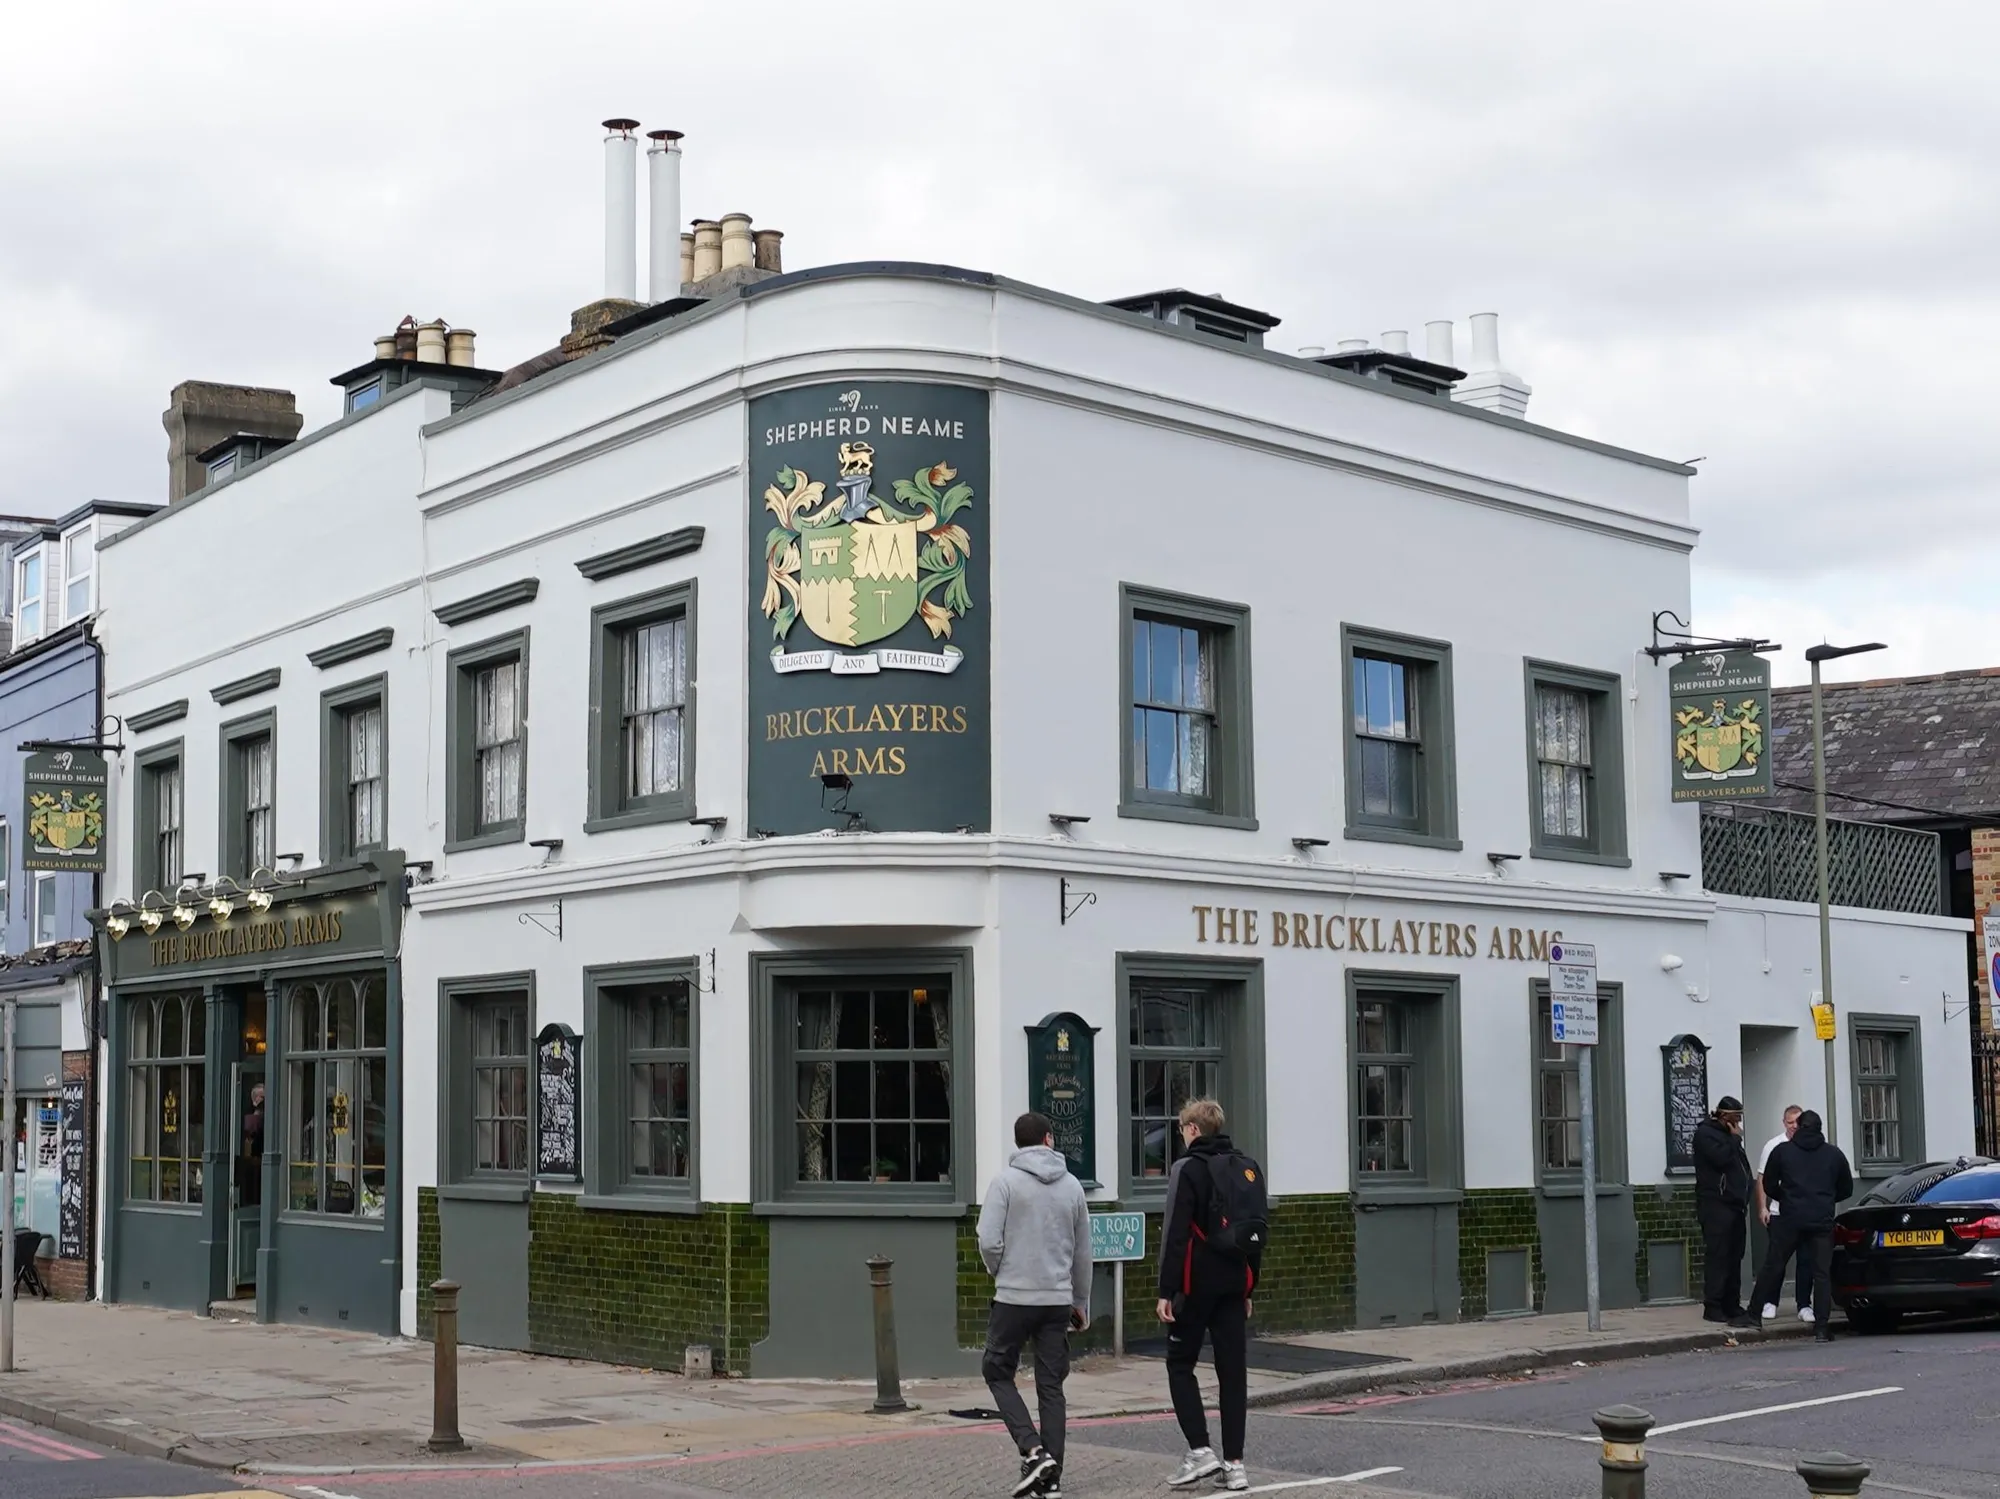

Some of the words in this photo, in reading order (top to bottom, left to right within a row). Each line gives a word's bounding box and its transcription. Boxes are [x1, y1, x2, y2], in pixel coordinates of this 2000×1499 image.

[766, 416, 871, 446] SHEPHERD
[882, 416, 964, 439] NEAME
[779, 653, 824, 669] DILIGENTLY
[842, 659, 865, 669] AND
[886, 652, 949, 668] FAITHFULLY
[1673, 678, 1725, 691] SHEPHERD
[1728, 675, 1763, 686] NEAME
[766, 704, 967, 741] BRICKLAYERS
[810, 746, 906, 778] ARMS
[28, 772, 74, 782] SHEPHERD
[76, 774, 105, 783] NEAME
[1674, 787, 1736, 799] BRICKLAYERS
[1739, 785, 1766, 795] ARMS
[26, 860, 79, 869] BRICKLAYERS
[81, 862, 103, 870] ARMS
[150, 937, 177, 967] THE
[183, 919, 286, 962] BRICKLAYERS
[292, 910, 343, 946] ARMS
[1192, 905, 1259, 945] THE
[1272, 911, 1477, 958] BRICKLAYERS
[1577, 949, 1594, 957] ROUTE
[1051, 1099, 1077, 1117] FOOD
[1106, 1217, 1140, 1233] ROAD
[1888, 1231, 1913, 1244] YC18
[1916, 1230, 1939, 1242] HNY
[1104, 1246, 1125, 1256] ROAD
